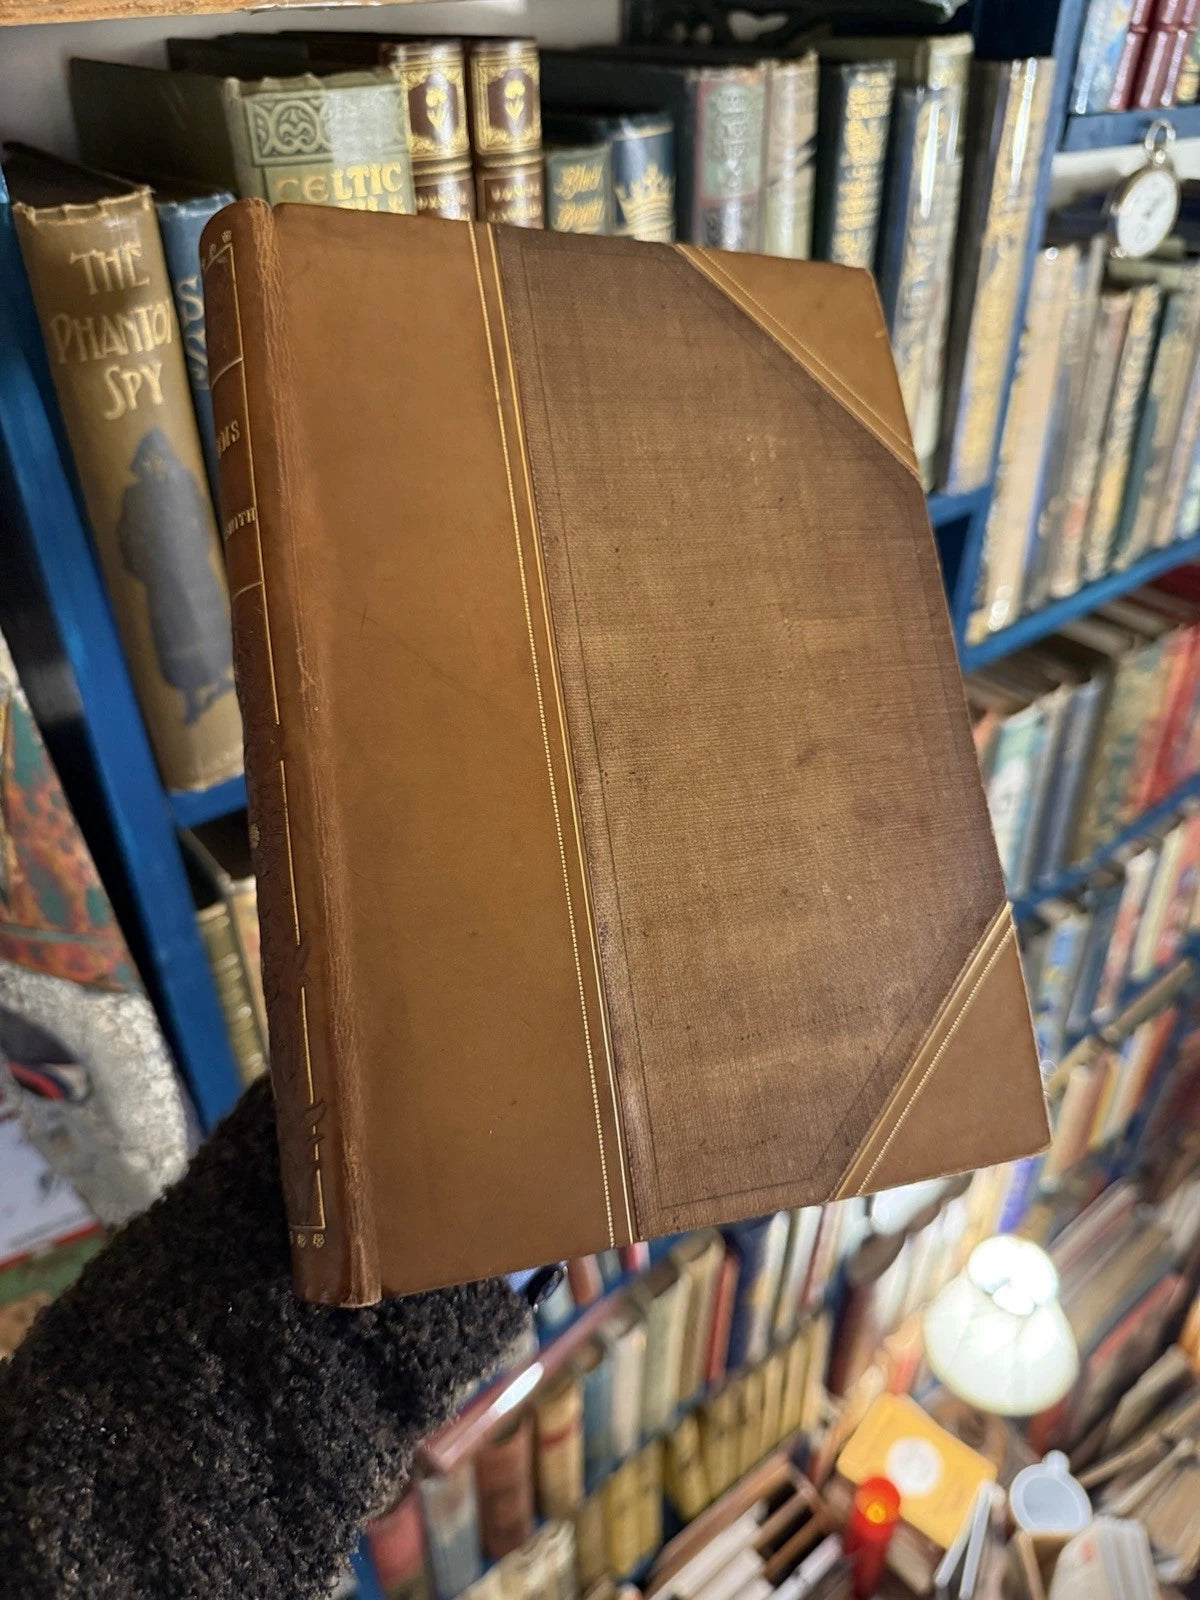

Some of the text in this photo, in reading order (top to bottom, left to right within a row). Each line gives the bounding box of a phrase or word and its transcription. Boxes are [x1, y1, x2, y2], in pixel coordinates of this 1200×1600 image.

[276, 162, 404, 203] CELTIC
[69, 241, 150, 295] THE
[104, 361, 164, 421] SPY
